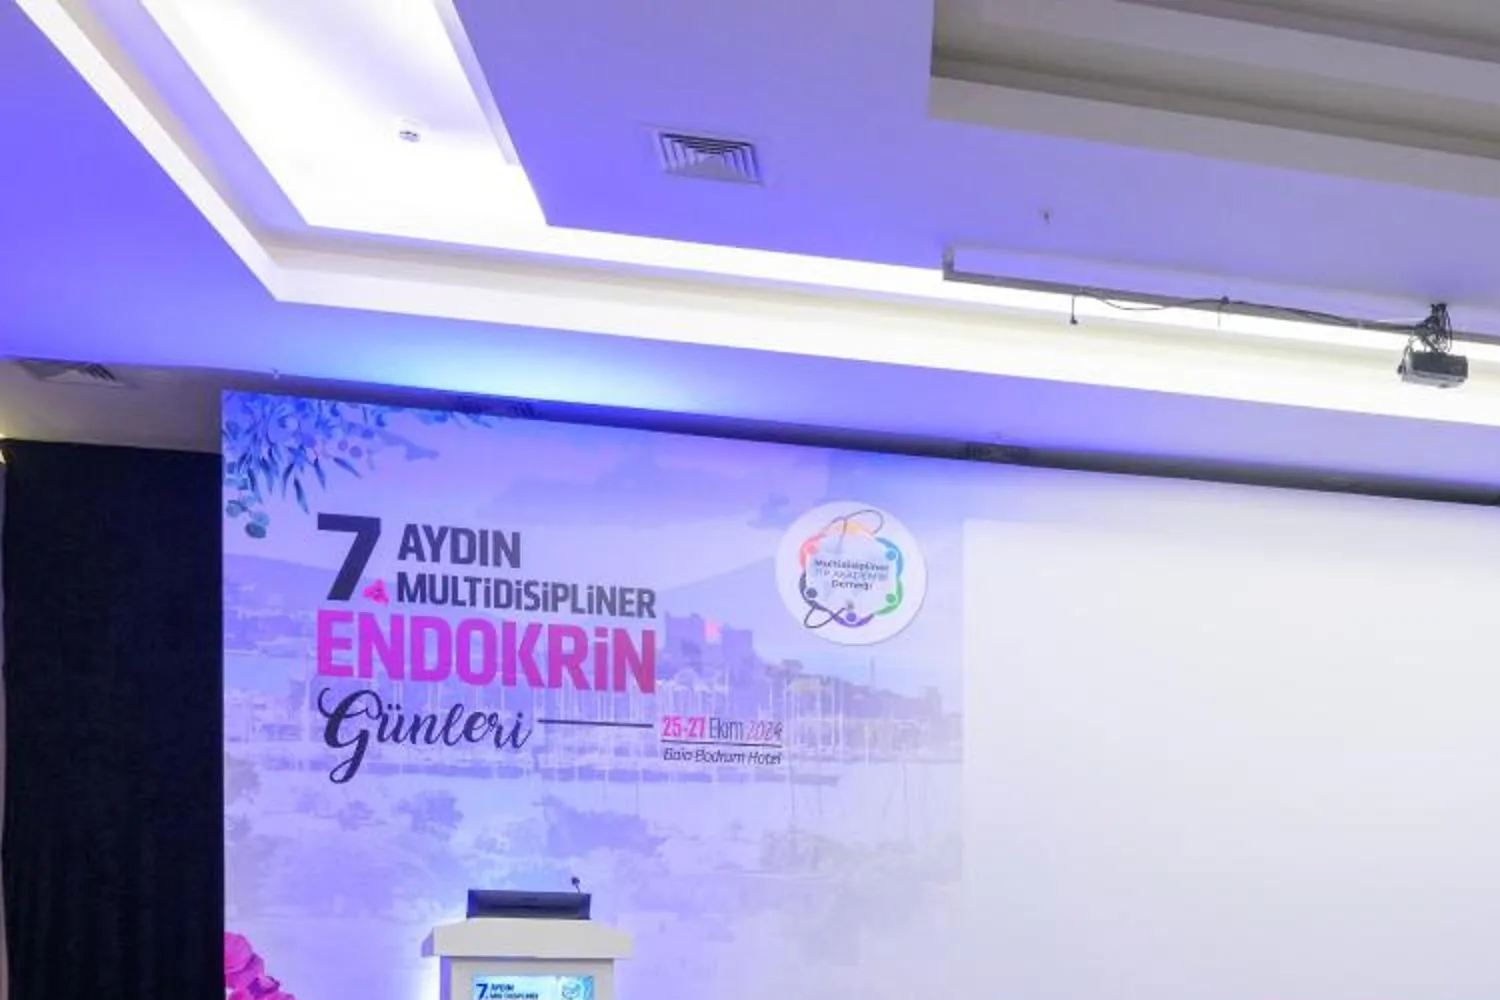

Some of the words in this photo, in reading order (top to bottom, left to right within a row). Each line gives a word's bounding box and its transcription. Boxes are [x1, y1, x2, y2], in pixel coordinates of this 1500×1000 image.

[397, 523, 522, 569] AYDIN
[317, 687, 532, 785] Günleri
[662, 715, 706, 738] 25-27
